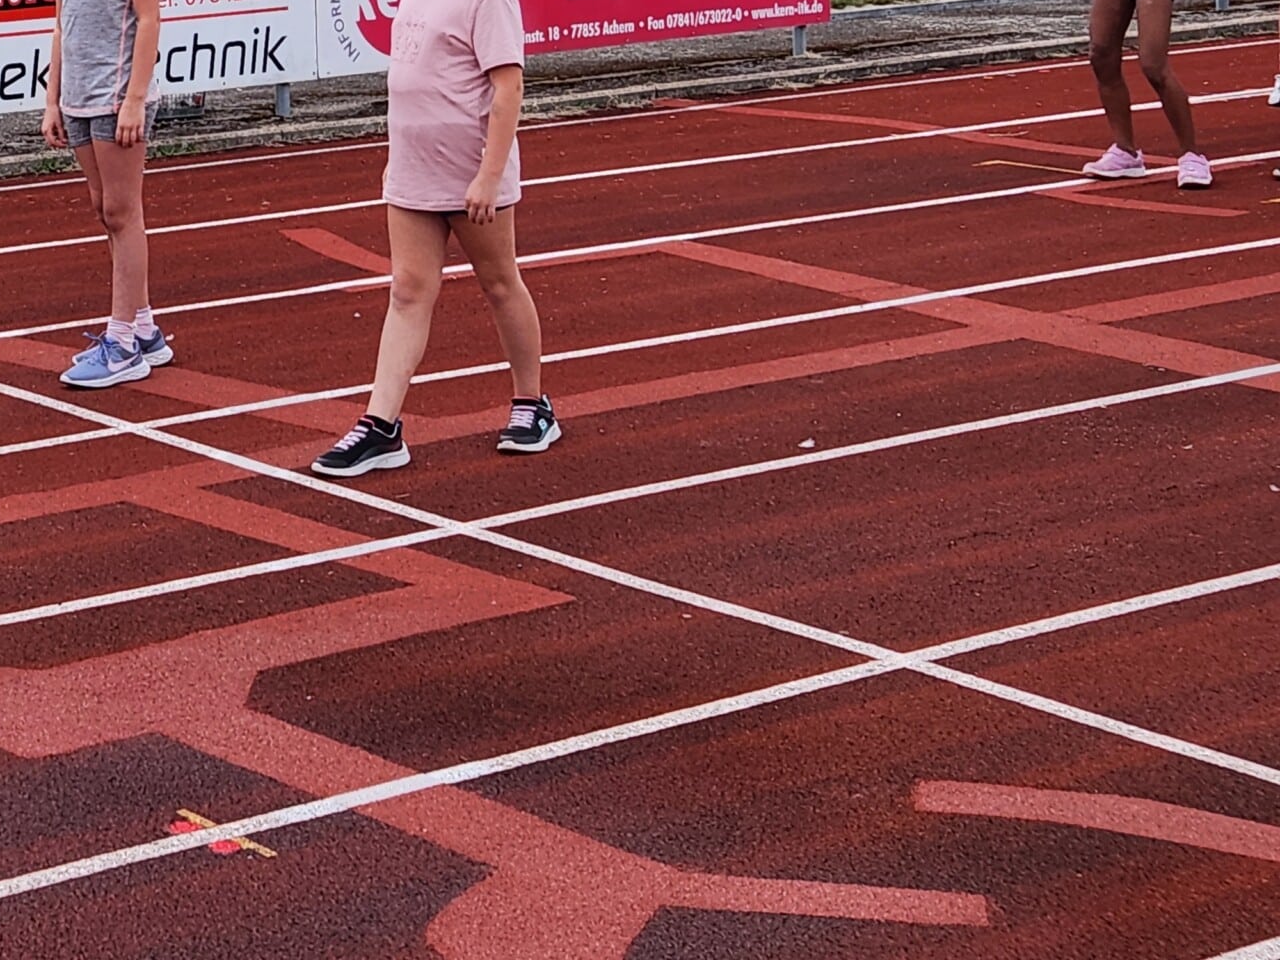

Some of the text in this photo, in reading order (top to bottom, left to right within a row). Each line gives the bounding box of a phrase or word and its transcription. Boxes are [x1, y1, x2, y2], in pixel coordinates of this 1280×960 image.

[548, 26, 560, 41] 18
[571, 21, 600, 39] 77855
[602, 19, 635, 36] Achern
[647, 16, 665, 30] Fon
[666, 7, 743, 29] 07841/673022-0
